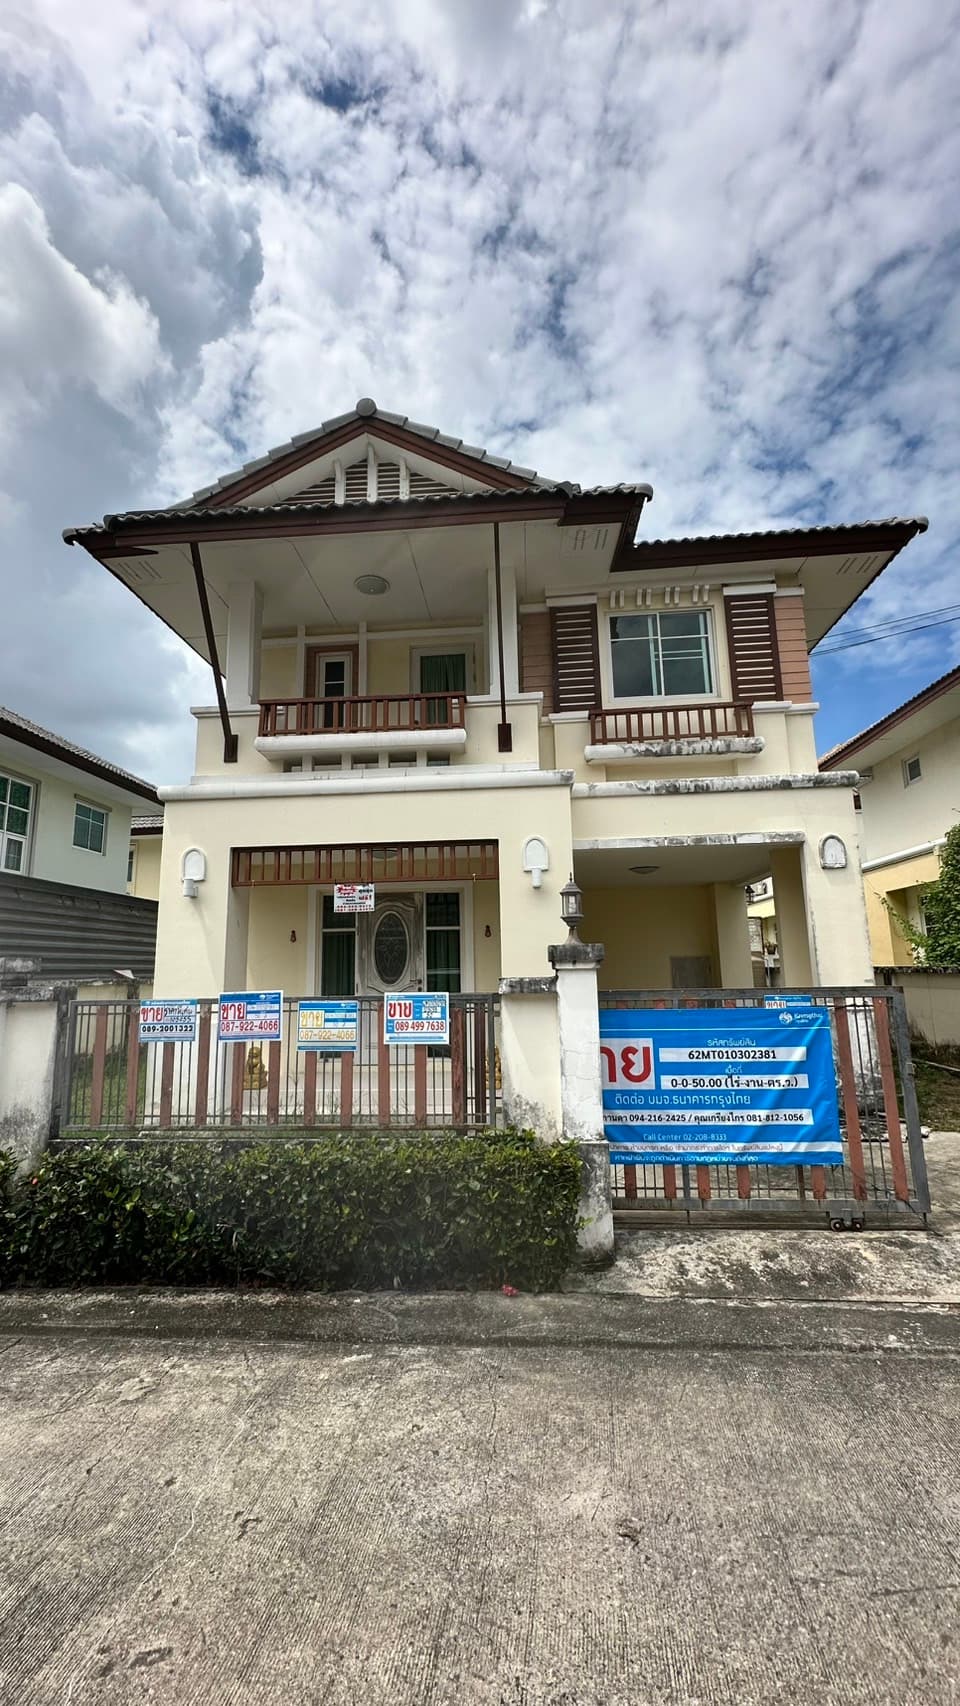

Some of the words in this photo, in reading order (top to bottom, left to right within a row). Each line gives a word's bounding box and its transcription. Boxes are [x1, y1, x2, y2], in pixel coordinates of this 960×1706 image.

[141, 1007, 164, 1022] ขาย
[221, 1003, 245, 1020] ขาย
[388, 1002, 412, 1018] ขาย
[301, 1011, 323, 1027] ขาย
[221, 1020, 278, 1032] 087-922-4066
[395, 1021, 409, 1032] 089
[410, 1021, 425, 1031] 499
[426, 1021, 445, 1031] 7638
[300, 1030, 355, 1040] 087-922-4066
[707, 1037, 756, 1047] รหัสทรัพย์สิน
[688, 1049, 777, 1060] 62MT010302381
[600, 1045, 652, 1083] าย
[671, 1078, 722, 1088] 0-0-50.00
[615, 1092, 645, 1105] ติดต่อ
[648, 1091, 751, 1108] บมจ.ธนาคารกรุงไทย
[629, 1113, 686, 1122] 094-216-2425
[694, 1111, 745, 1125] คุณเกรียงไกร
[746, 1112, 804, 1122] 081-812-1056
[643, 1133, 656, 1141] Call
[657, 1133, 681, 1141] Center
[682, 1132, 727, 1141] 02-208-8333
